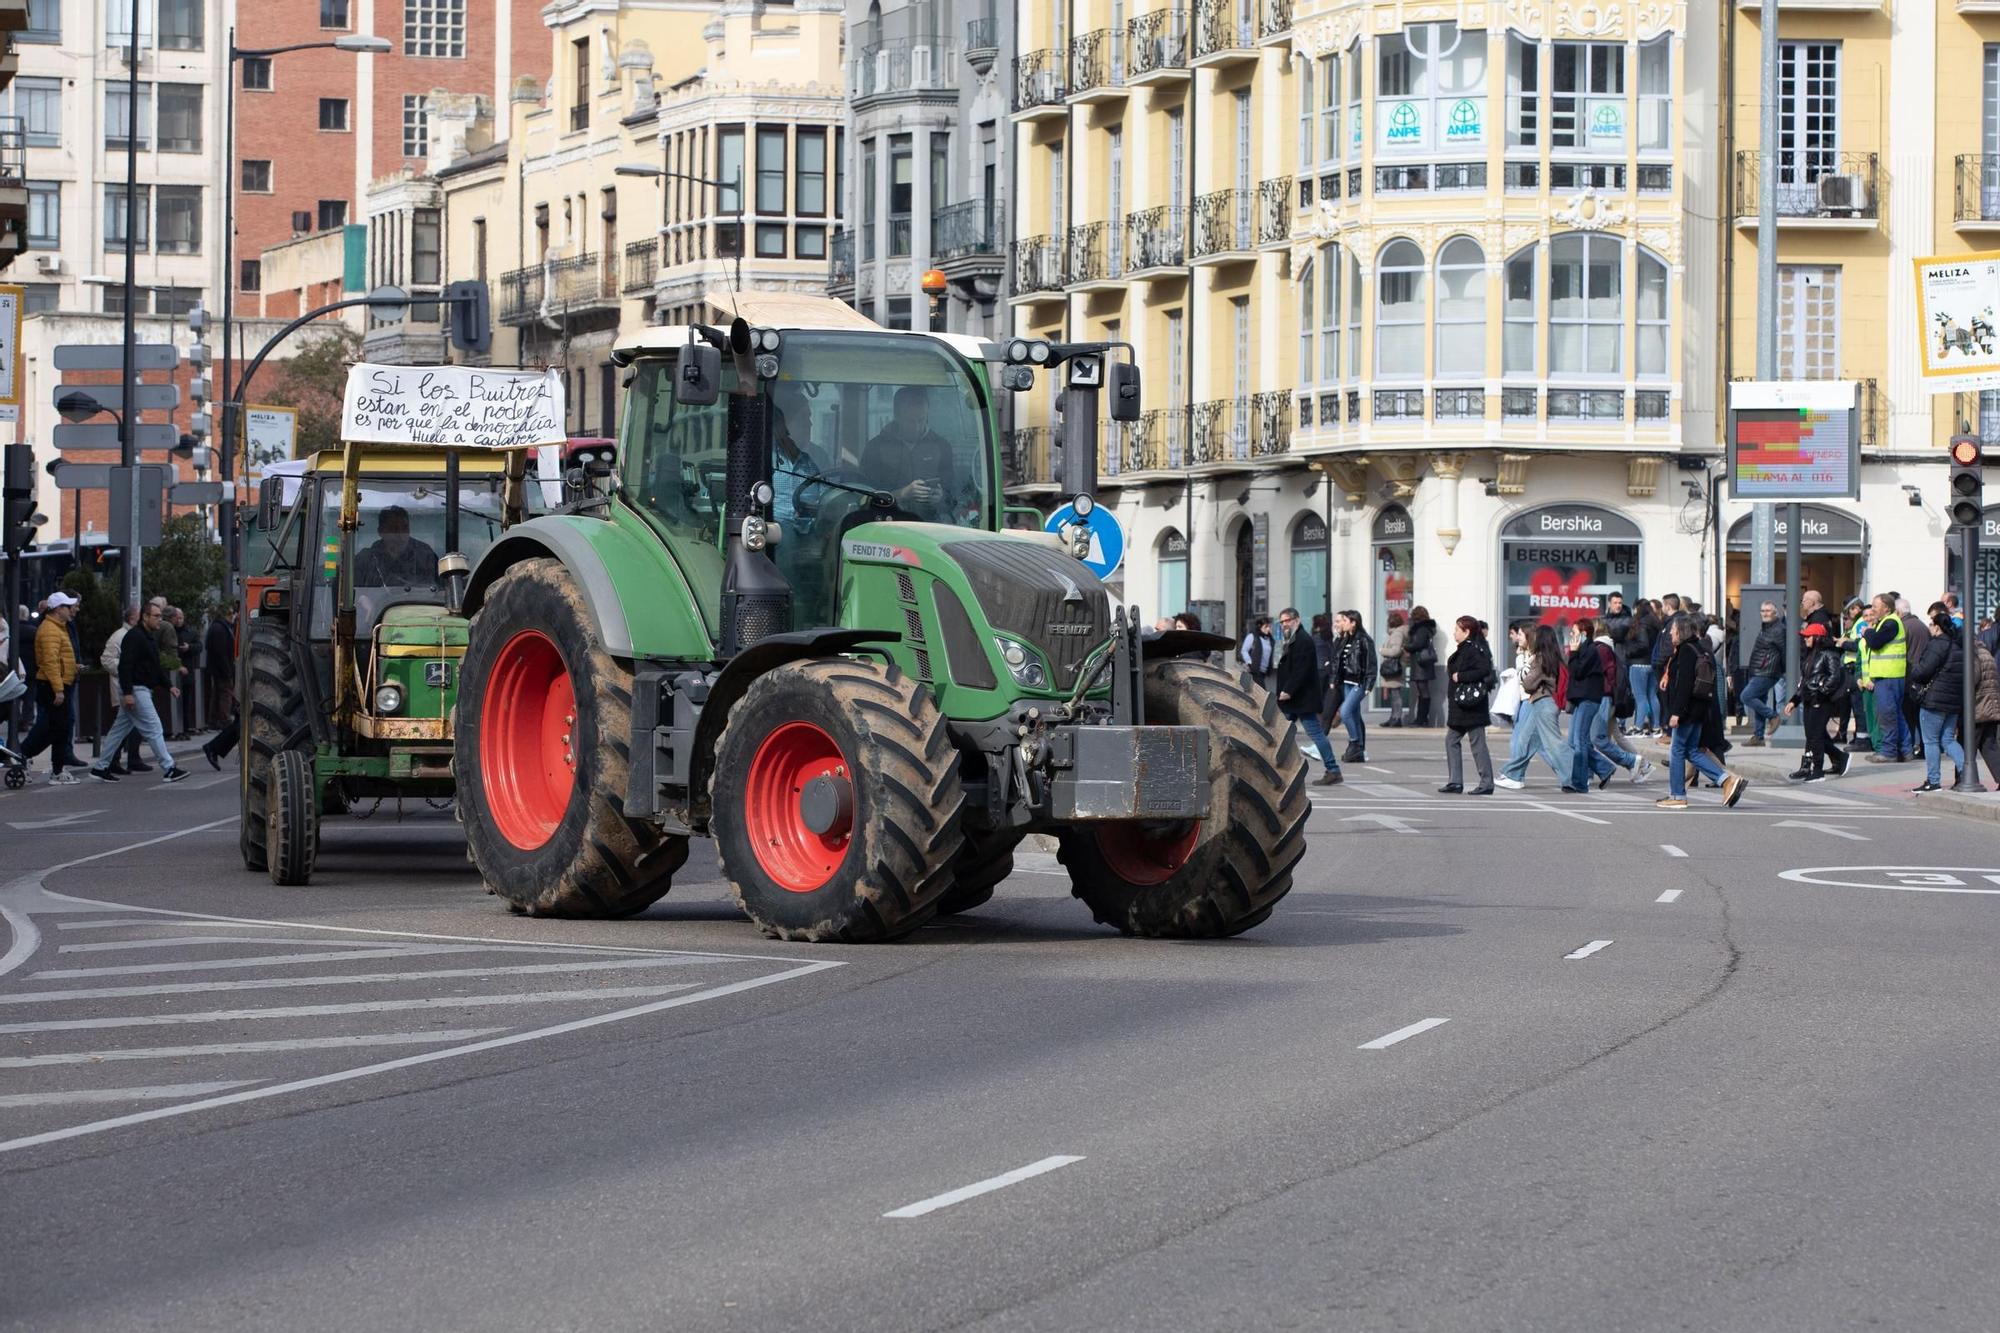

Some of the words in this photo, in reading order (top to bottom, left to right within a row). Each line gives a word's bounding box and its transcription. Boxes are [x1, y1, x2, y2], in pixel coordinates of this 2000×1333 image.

[1387, 127, 1421, 138] ANPE
[1447, 124, 1480, 135] ANPE
[1592, 124, 1622, 134] ANPE
[1929, 268, 1970, 279] MELIZA
[371, 371, 405, 395] Si
[418, 373, 459, 399] los
[470, 375, 552, 402] Buitres
[358, 395, 410, 415] estan
[419, 403, 443, 417] en
[453, 402, 471, 417] el
[483, 401, 539, 424] poder
[355, 414, 371, 426] es
[378, 417, 402, 430] por
[440, 415, 460, 429] la
[412, 429, 448, 443] Huele
[455, 433, 466, 442] a
[1384, 518, 1406, 534] Bershka
[1540, 515, 1603, 531] Bershka
[1774, 519, 1829, 535] ehka
[1303, 526, 1326, 541] Bershka
[852, 544, 877, 557] FENDT
[878, 547, 891, 558] 718
[1516, 550, 1600, 563] BERSHKA
[1530, 595, 1600, 609] REBAJAS
[1049, 624, 1092, 635] FENDT
